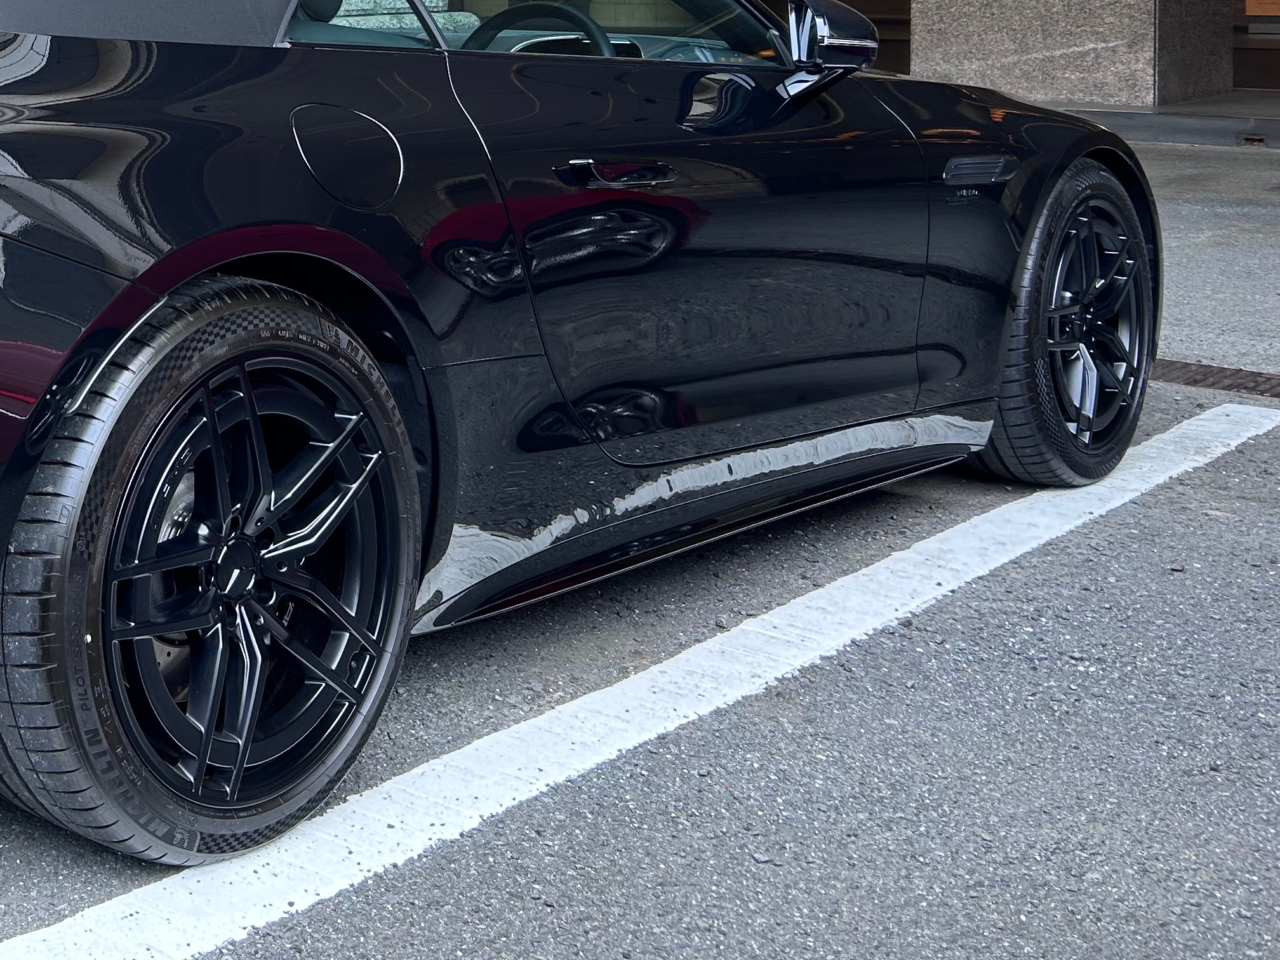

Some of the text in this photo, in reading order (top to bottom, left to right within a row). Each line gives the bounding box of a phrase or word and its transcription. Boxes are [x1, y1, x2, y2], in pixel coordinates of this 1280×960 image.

[342, 338, 411, 447] MICHELIN
[73, 665, 91, 712] PILOT
[83, 727, 172, 837] MICHELIN
